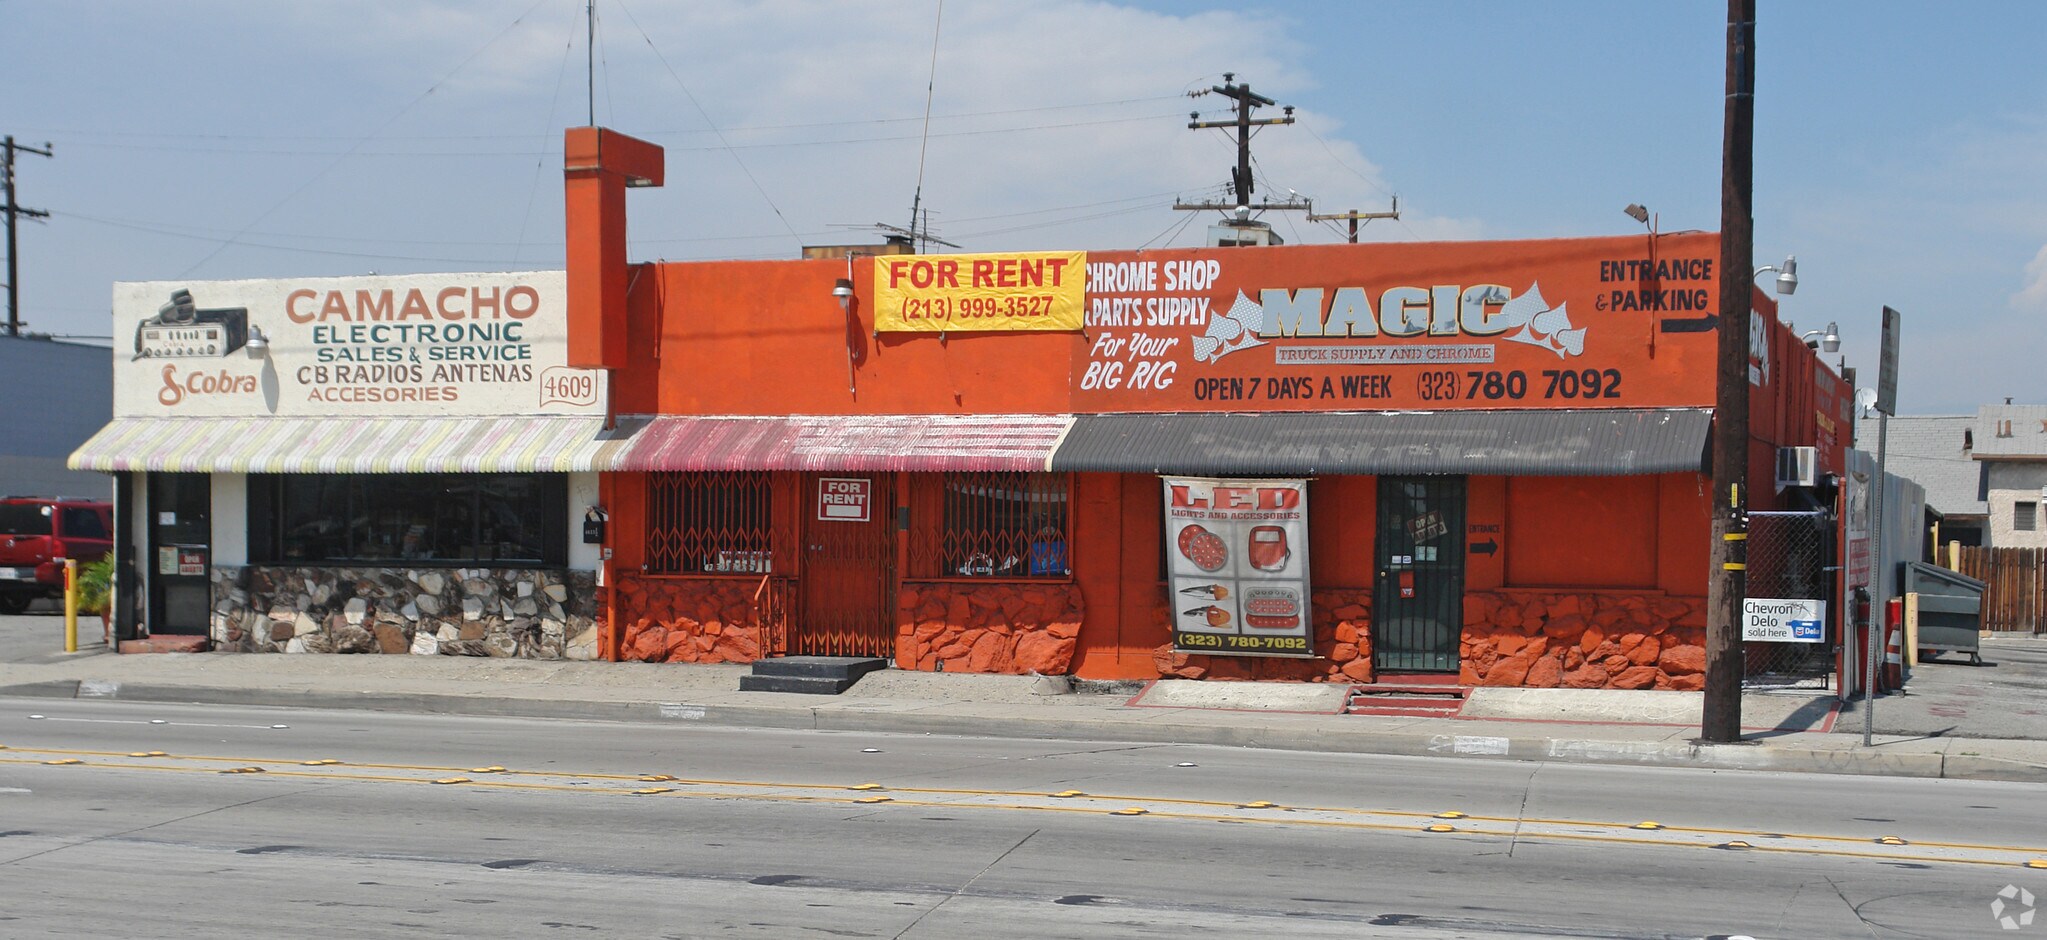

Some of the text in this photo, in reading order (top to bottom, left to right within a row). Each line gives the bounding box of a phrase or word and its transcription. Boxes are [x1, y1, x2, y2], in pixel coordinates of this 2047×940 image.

[889, 258, 1069, 288] FOR RENT
[1163, 259, 1220, 292] SHOP
[1601, 259, 1712, 281] ENTRANCE
[286, 285, 540, 325] CAMACHO
[901, 295, 1054, 321] (213) 999-3527
[1259, 284, 1512, 338] MAGIC
[1595, 288, 1708, 311] & PARKING
[1146, 297, 1210, 327] SUPPLY
[313, 321, 523, 345] ELECTRONIC
[317, 343, 532, 363] SALES & SERVICE
[1090, 332, 1179, 362] For Your
[1279, 347, 1491, 361] TRUCK SUPPLY AND CHROME
[186, 369, 256, 394] Cobra
[297, 363, 533, 385] CB RADIOS ANTENAS
[1080, 361, 1177, 390] BIG RIG
[1417, 368, 1622, 401] (323) 780 7092
[307, 385, 458, 403] ACCESORIES
[544, 375, 592, 398] 4609
[1194, 375, 1392, 400] OPEN 7 DAYS A WEEK
[822, 493, 866, 505] RENT
[828, 482, 861, 493] FOR
[1170, 485, 1300, 510] LED
[1171, 509, 1300, 520] LIGHTS AND ACCESSORIES
[1744, 602, 1793, 615] Chevron
[1748, 628, 1788, 637] sold here
[1751, 615, 1778, 627] Delo
[1178, 633, 1306, 649] (323) 780-7092
